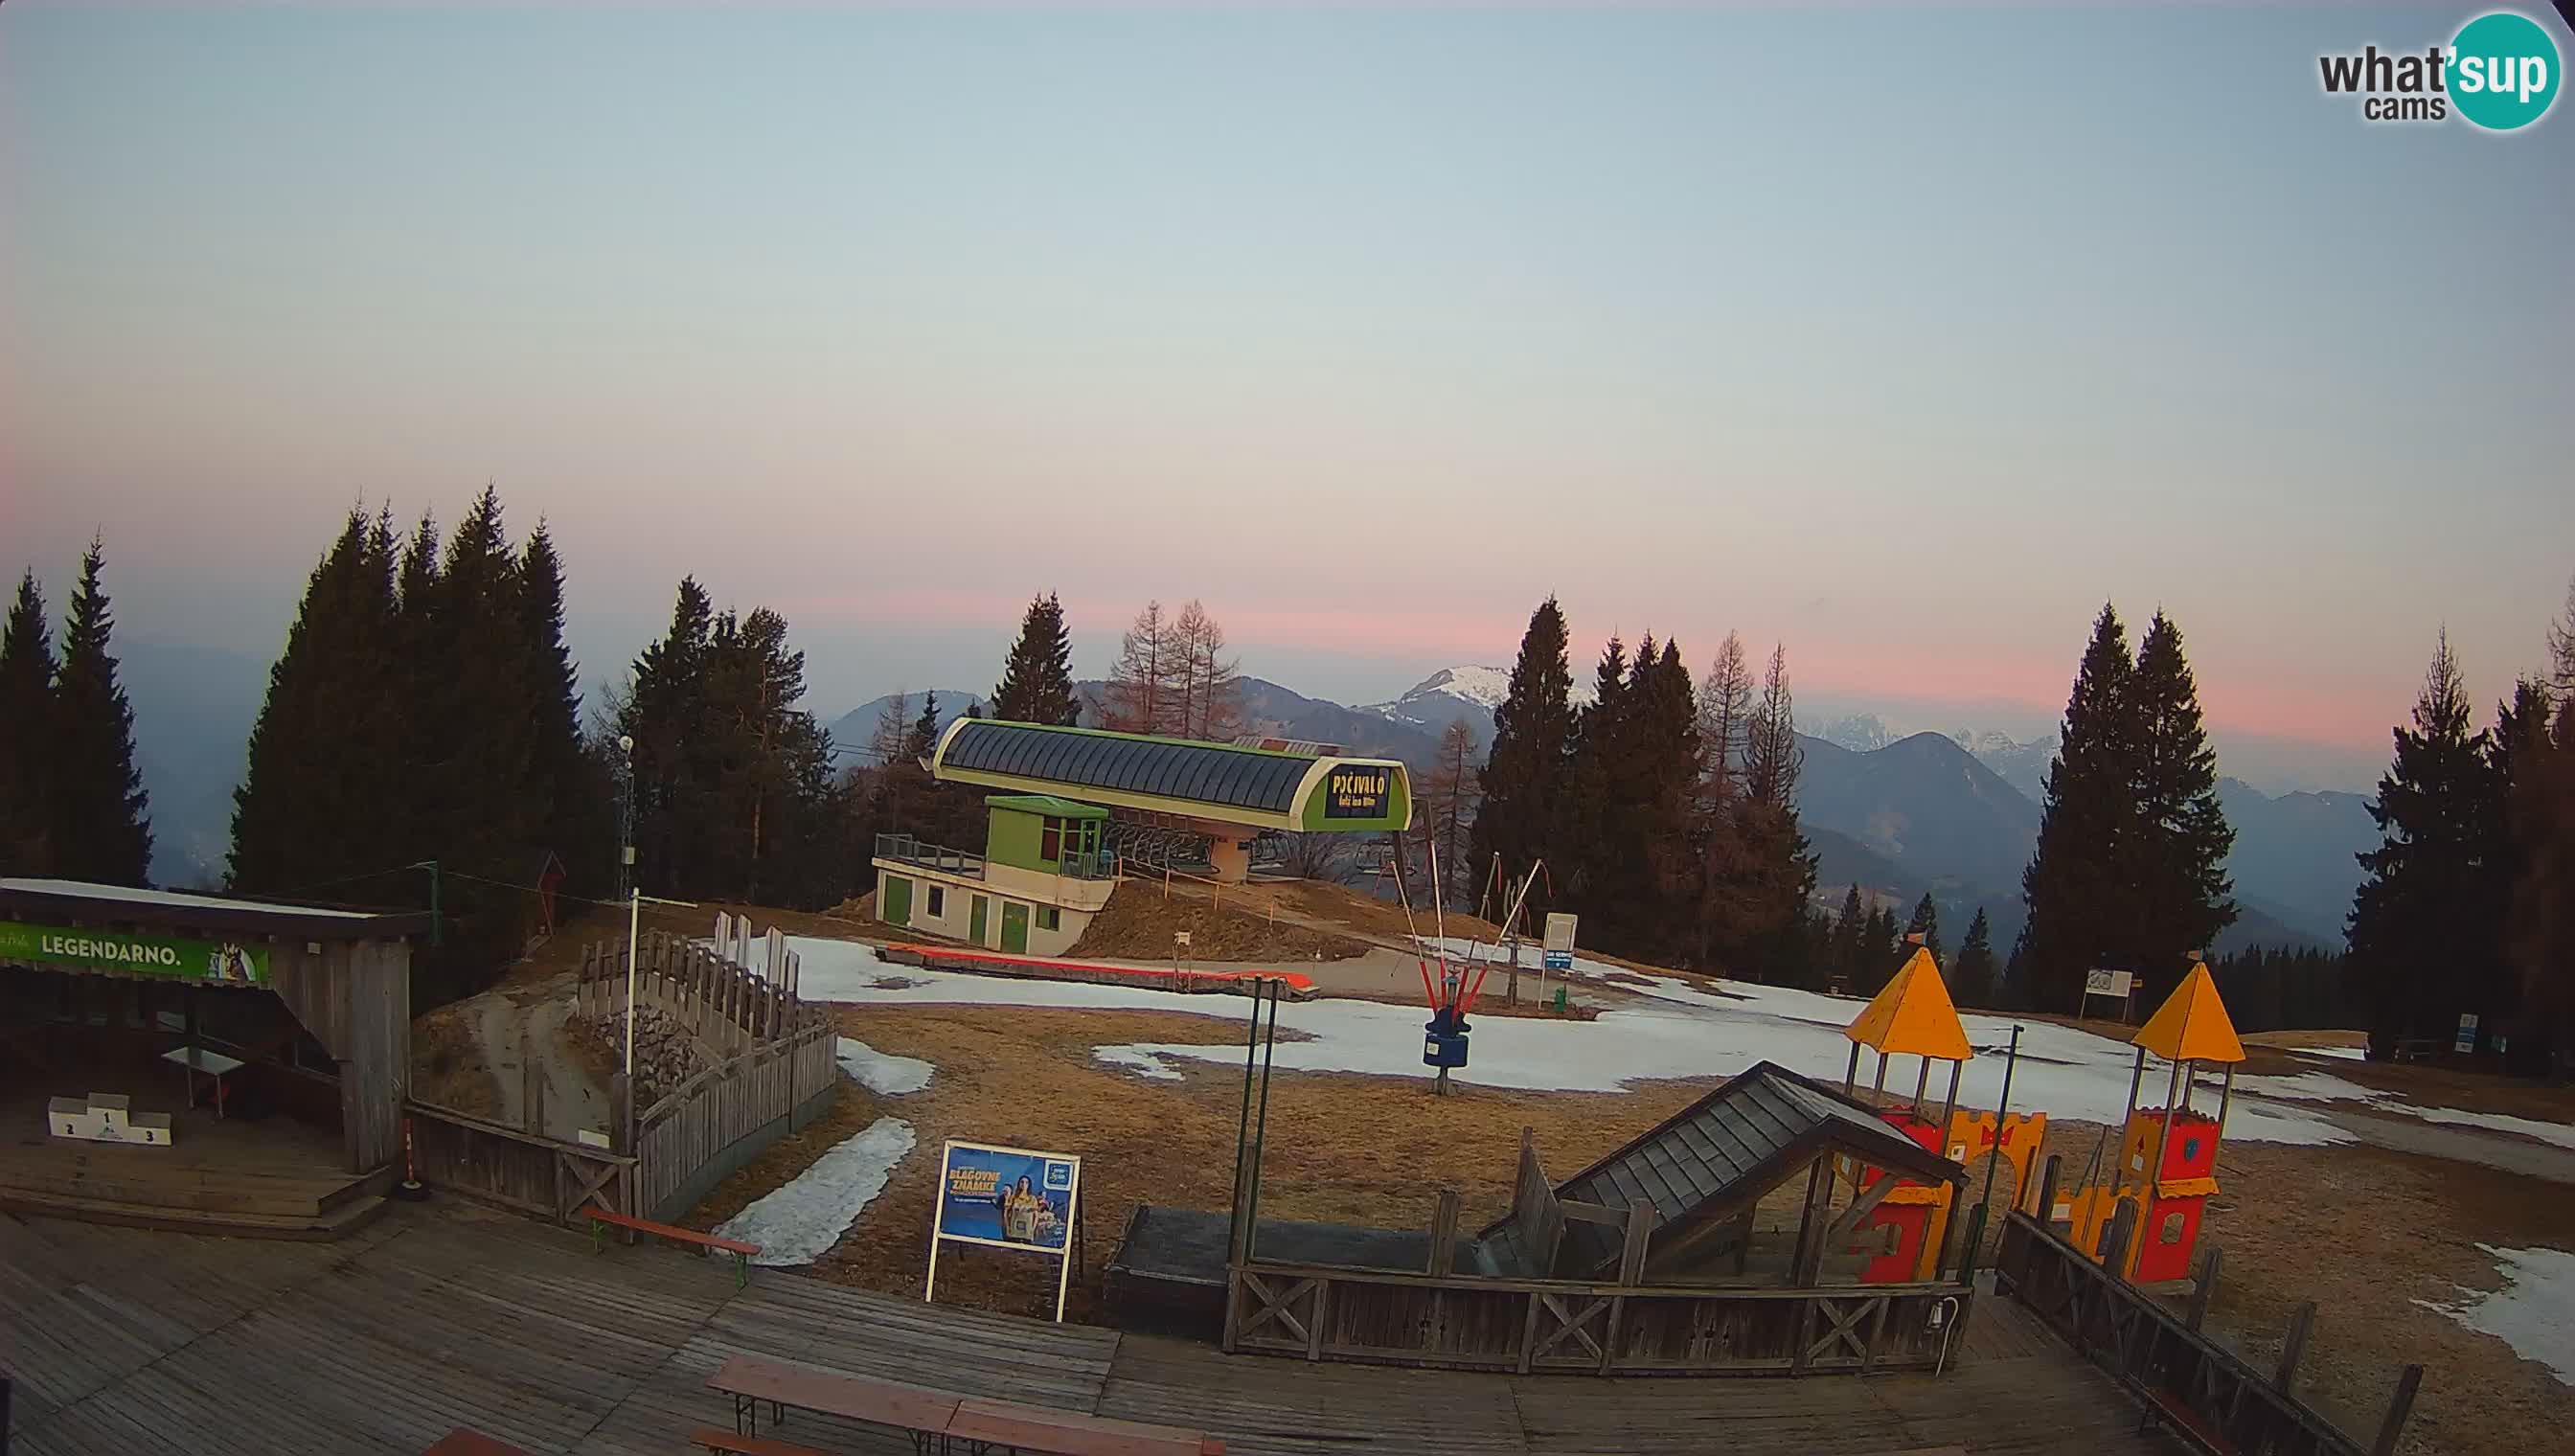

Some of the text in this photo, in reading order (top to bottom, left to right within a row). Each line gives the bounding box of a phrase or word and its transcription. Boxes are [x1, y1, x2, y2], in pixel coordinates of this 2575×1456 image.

[41, 934, 181, 967] LEGENDARNO.
[103, 1111, 110, 1123] 1
[66, 1124, 74, 1134] 2
[146, 1130, 154, 1142] 3
[949, 1169, 1001, 1182] BLAGOVNE
[952, 1179, 995, 1192] ZNAMKE
